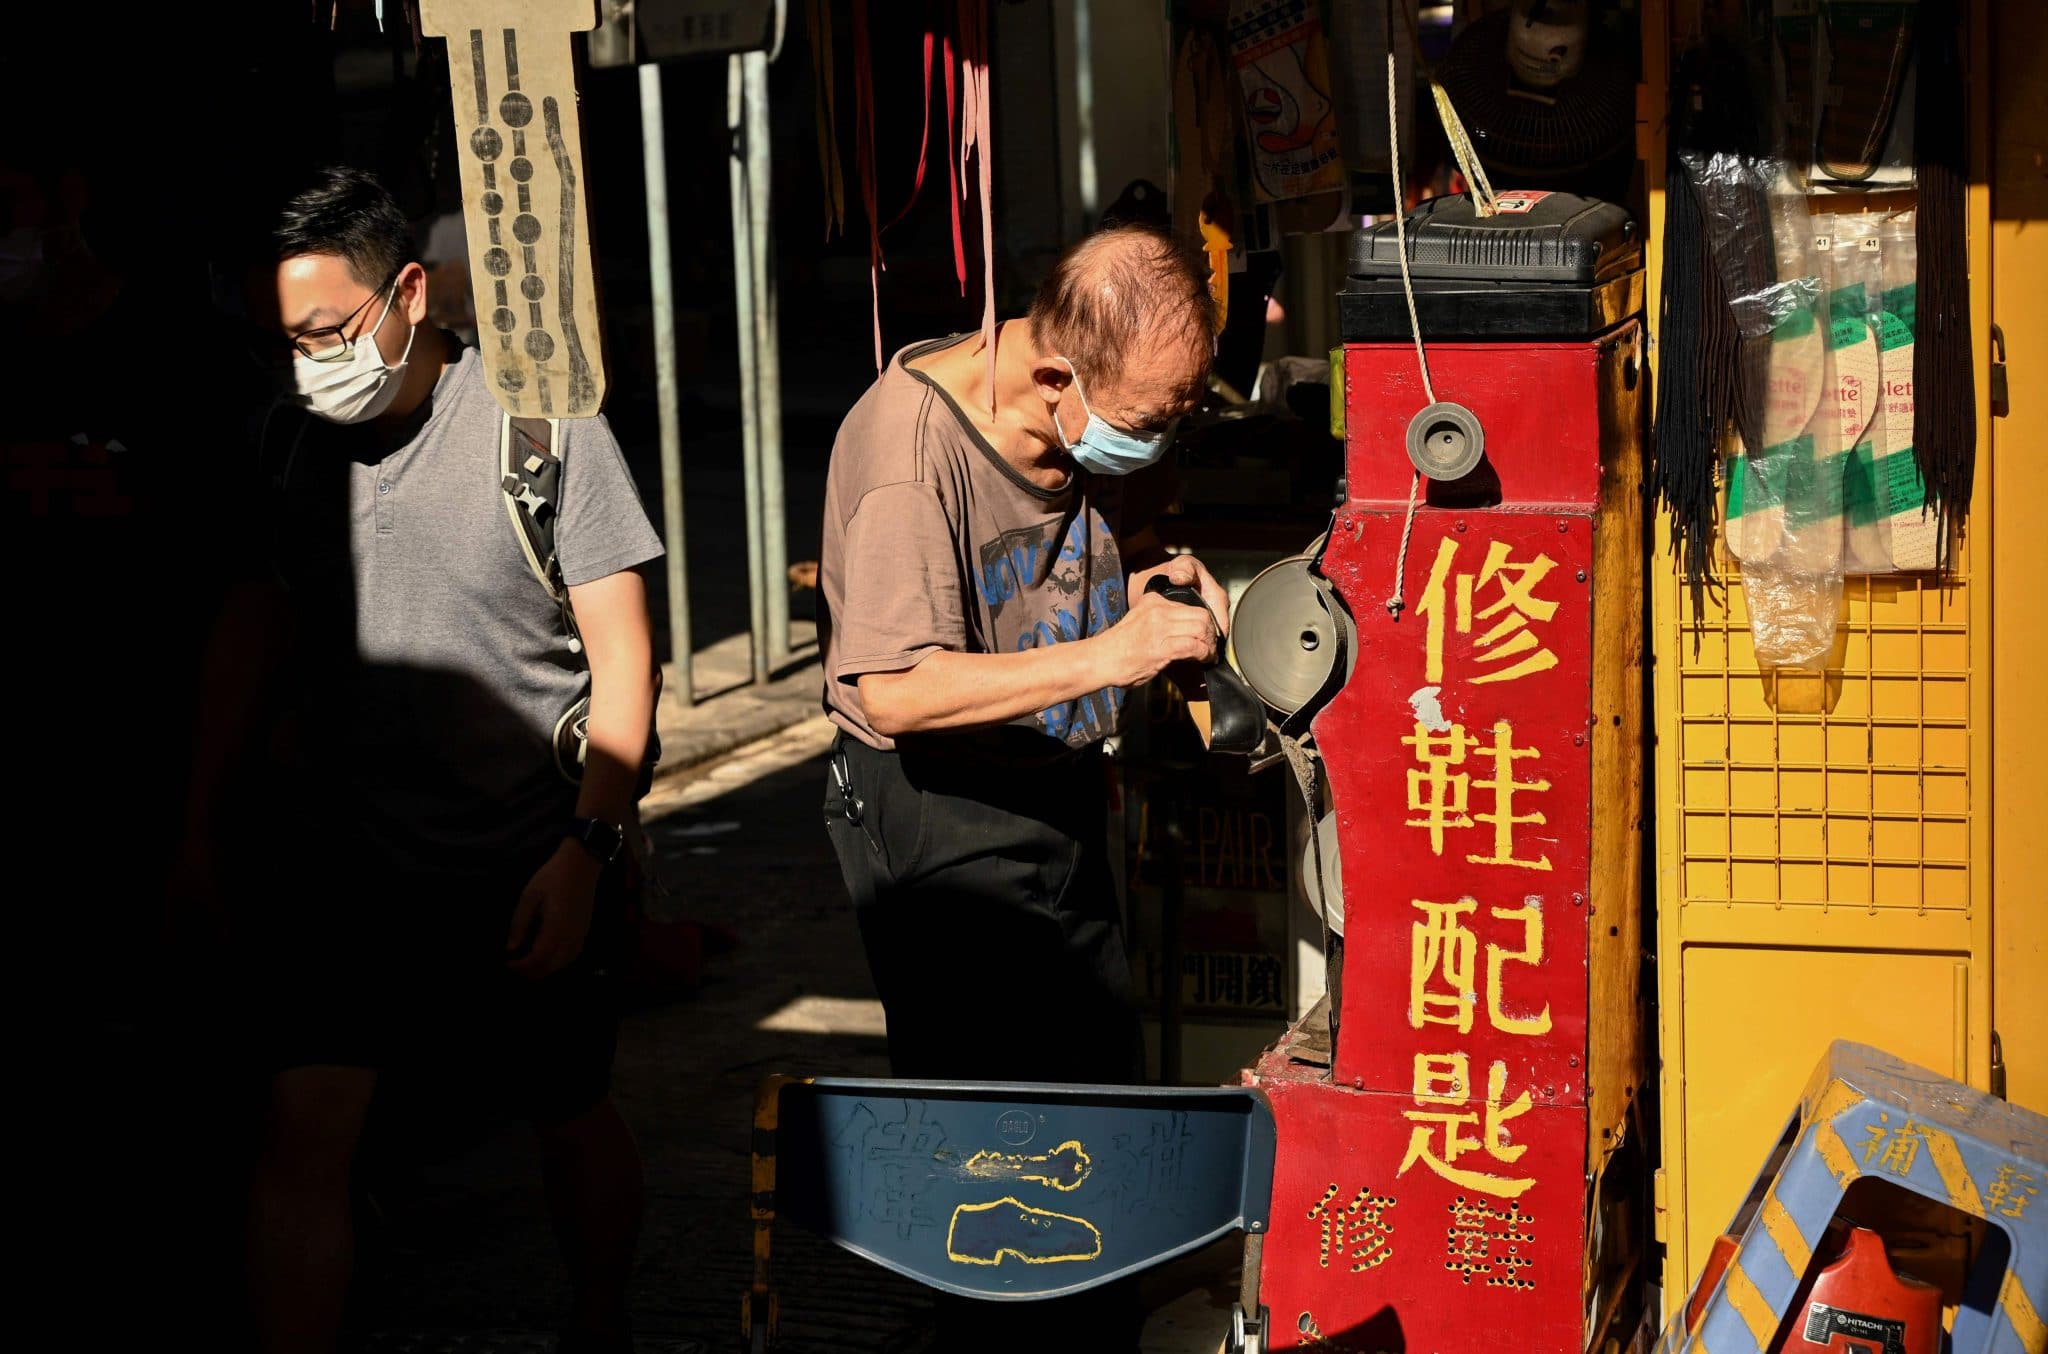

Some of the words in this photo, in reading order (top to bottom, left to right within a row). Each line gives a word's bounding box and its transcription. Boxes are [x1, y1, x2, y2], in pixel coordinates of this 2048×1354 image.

[1866, 239, 1876, 247] 41
[1184, 806, 1281, 889] PAIR
[1397, 536, 1560, 1198] 修鞋配匙
[1306, 1183, 1536, 1291] 修鞋
[1847, 1317, 1883, 1331] HITACHI
